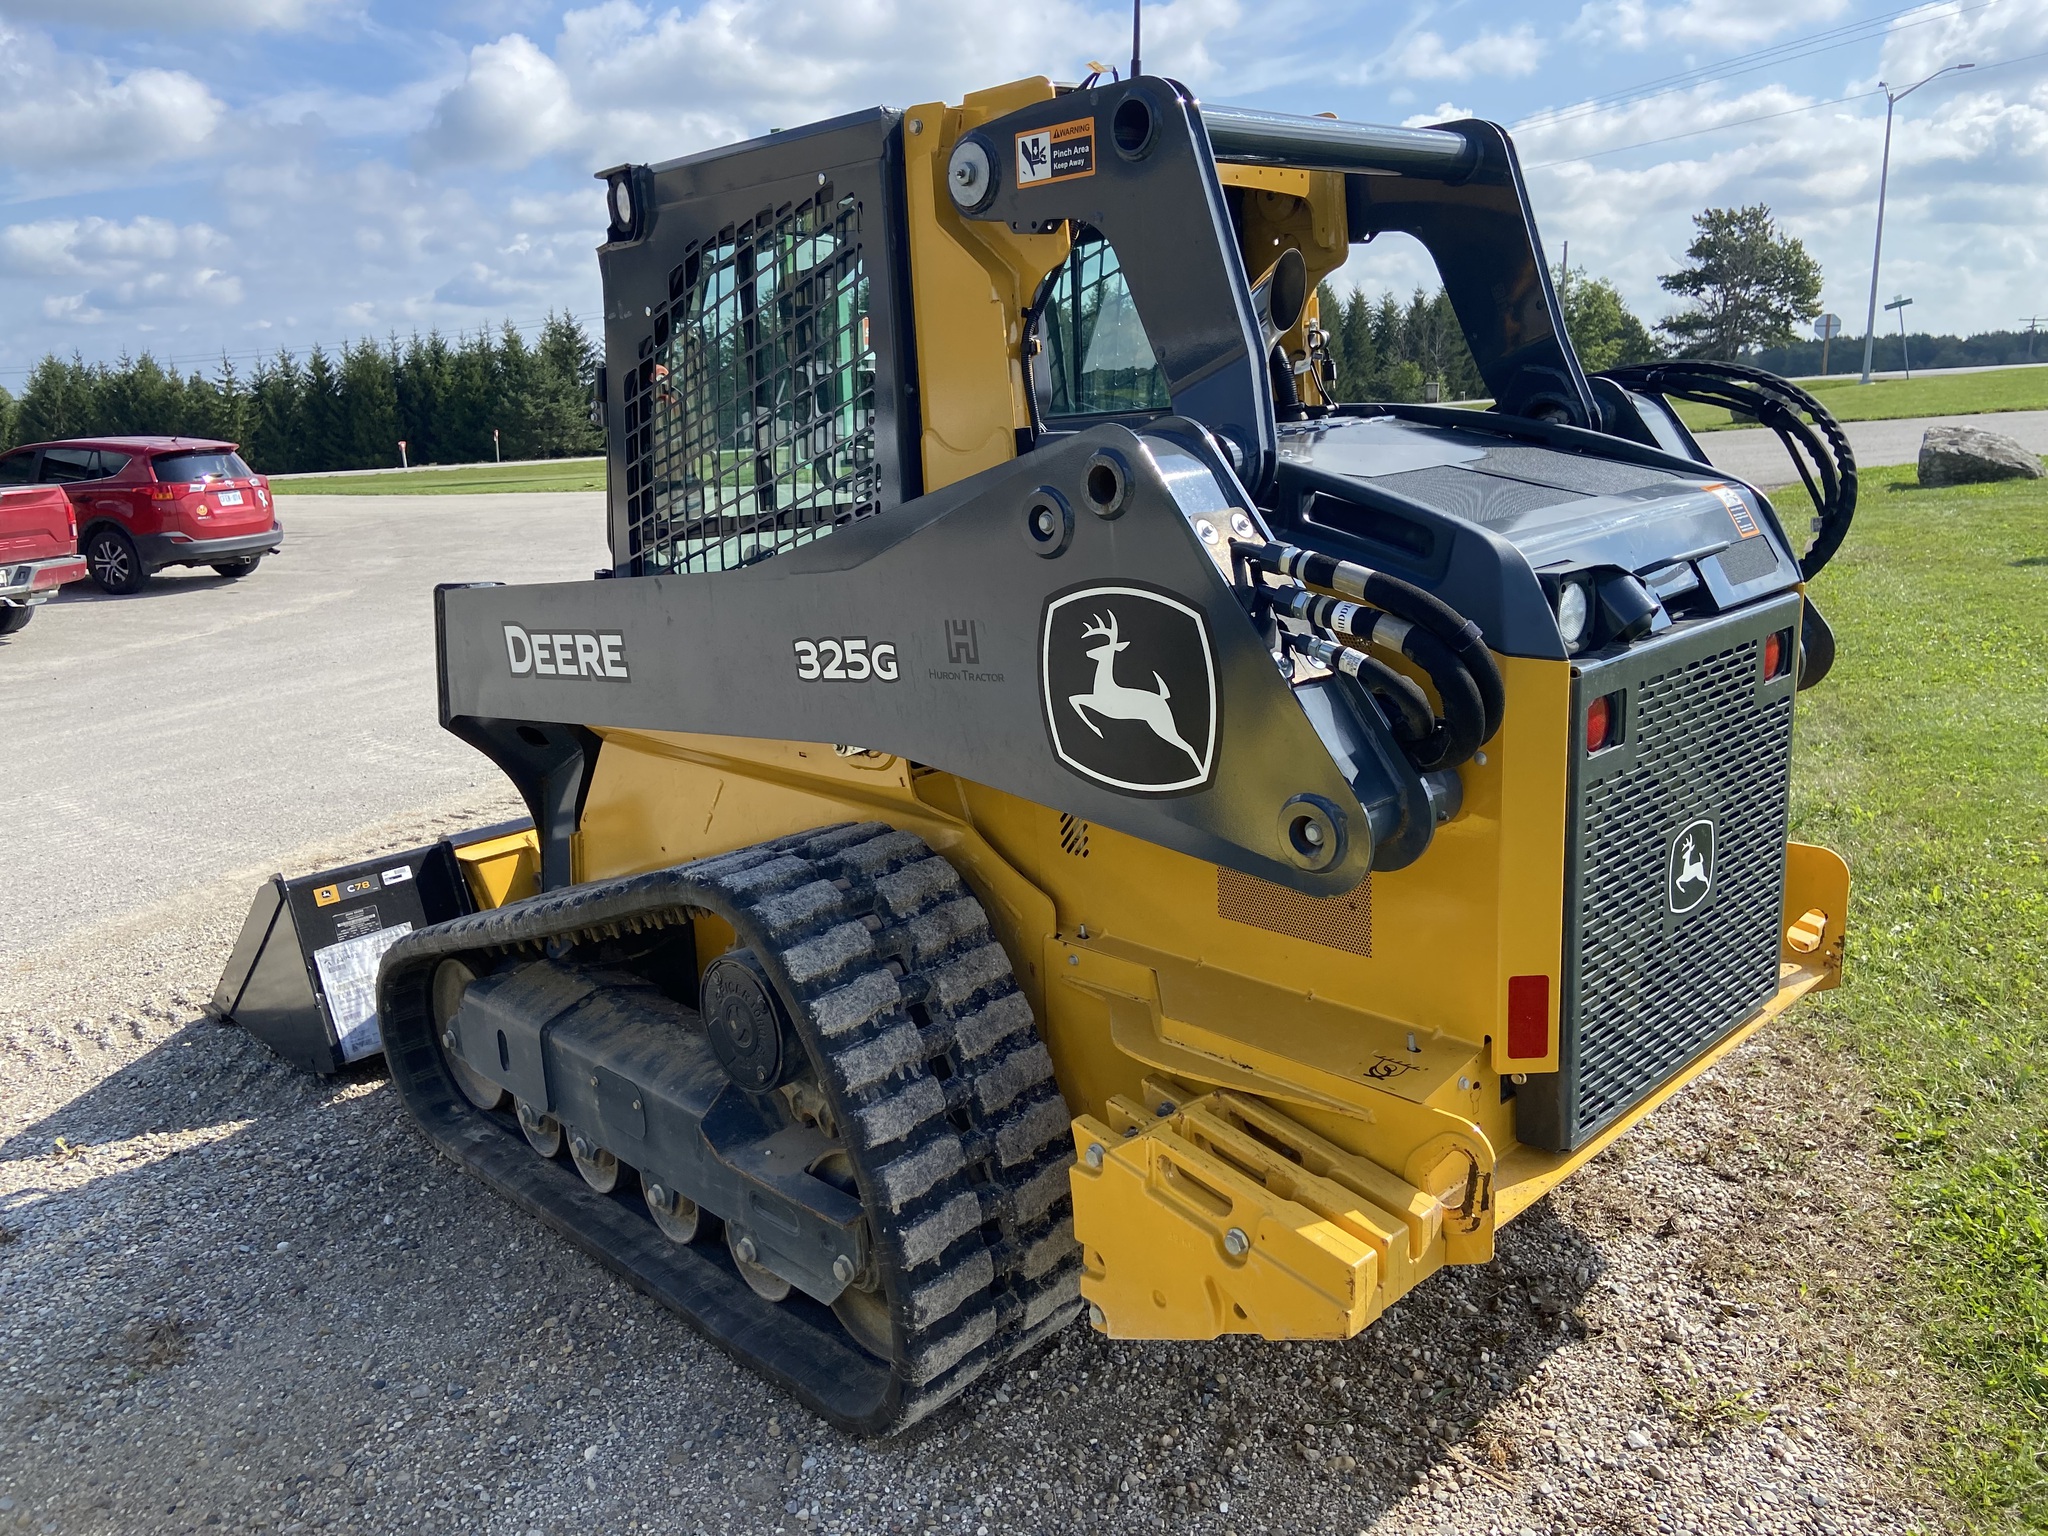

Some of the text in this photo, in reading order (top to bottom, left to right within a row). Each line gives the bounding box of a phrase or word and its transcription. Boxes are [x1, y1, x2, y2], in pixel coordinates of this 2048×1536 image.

[1059, 123, 1090, 137] WARNING
[1053, 145, 1090, 159] Pinch Area
[1053, 158, 1085, 171] Keep Away
[503, 625, 628, 678] DEERE
[794, 639, 899, 680] 325G
[346, 881, 371, 893] C78
